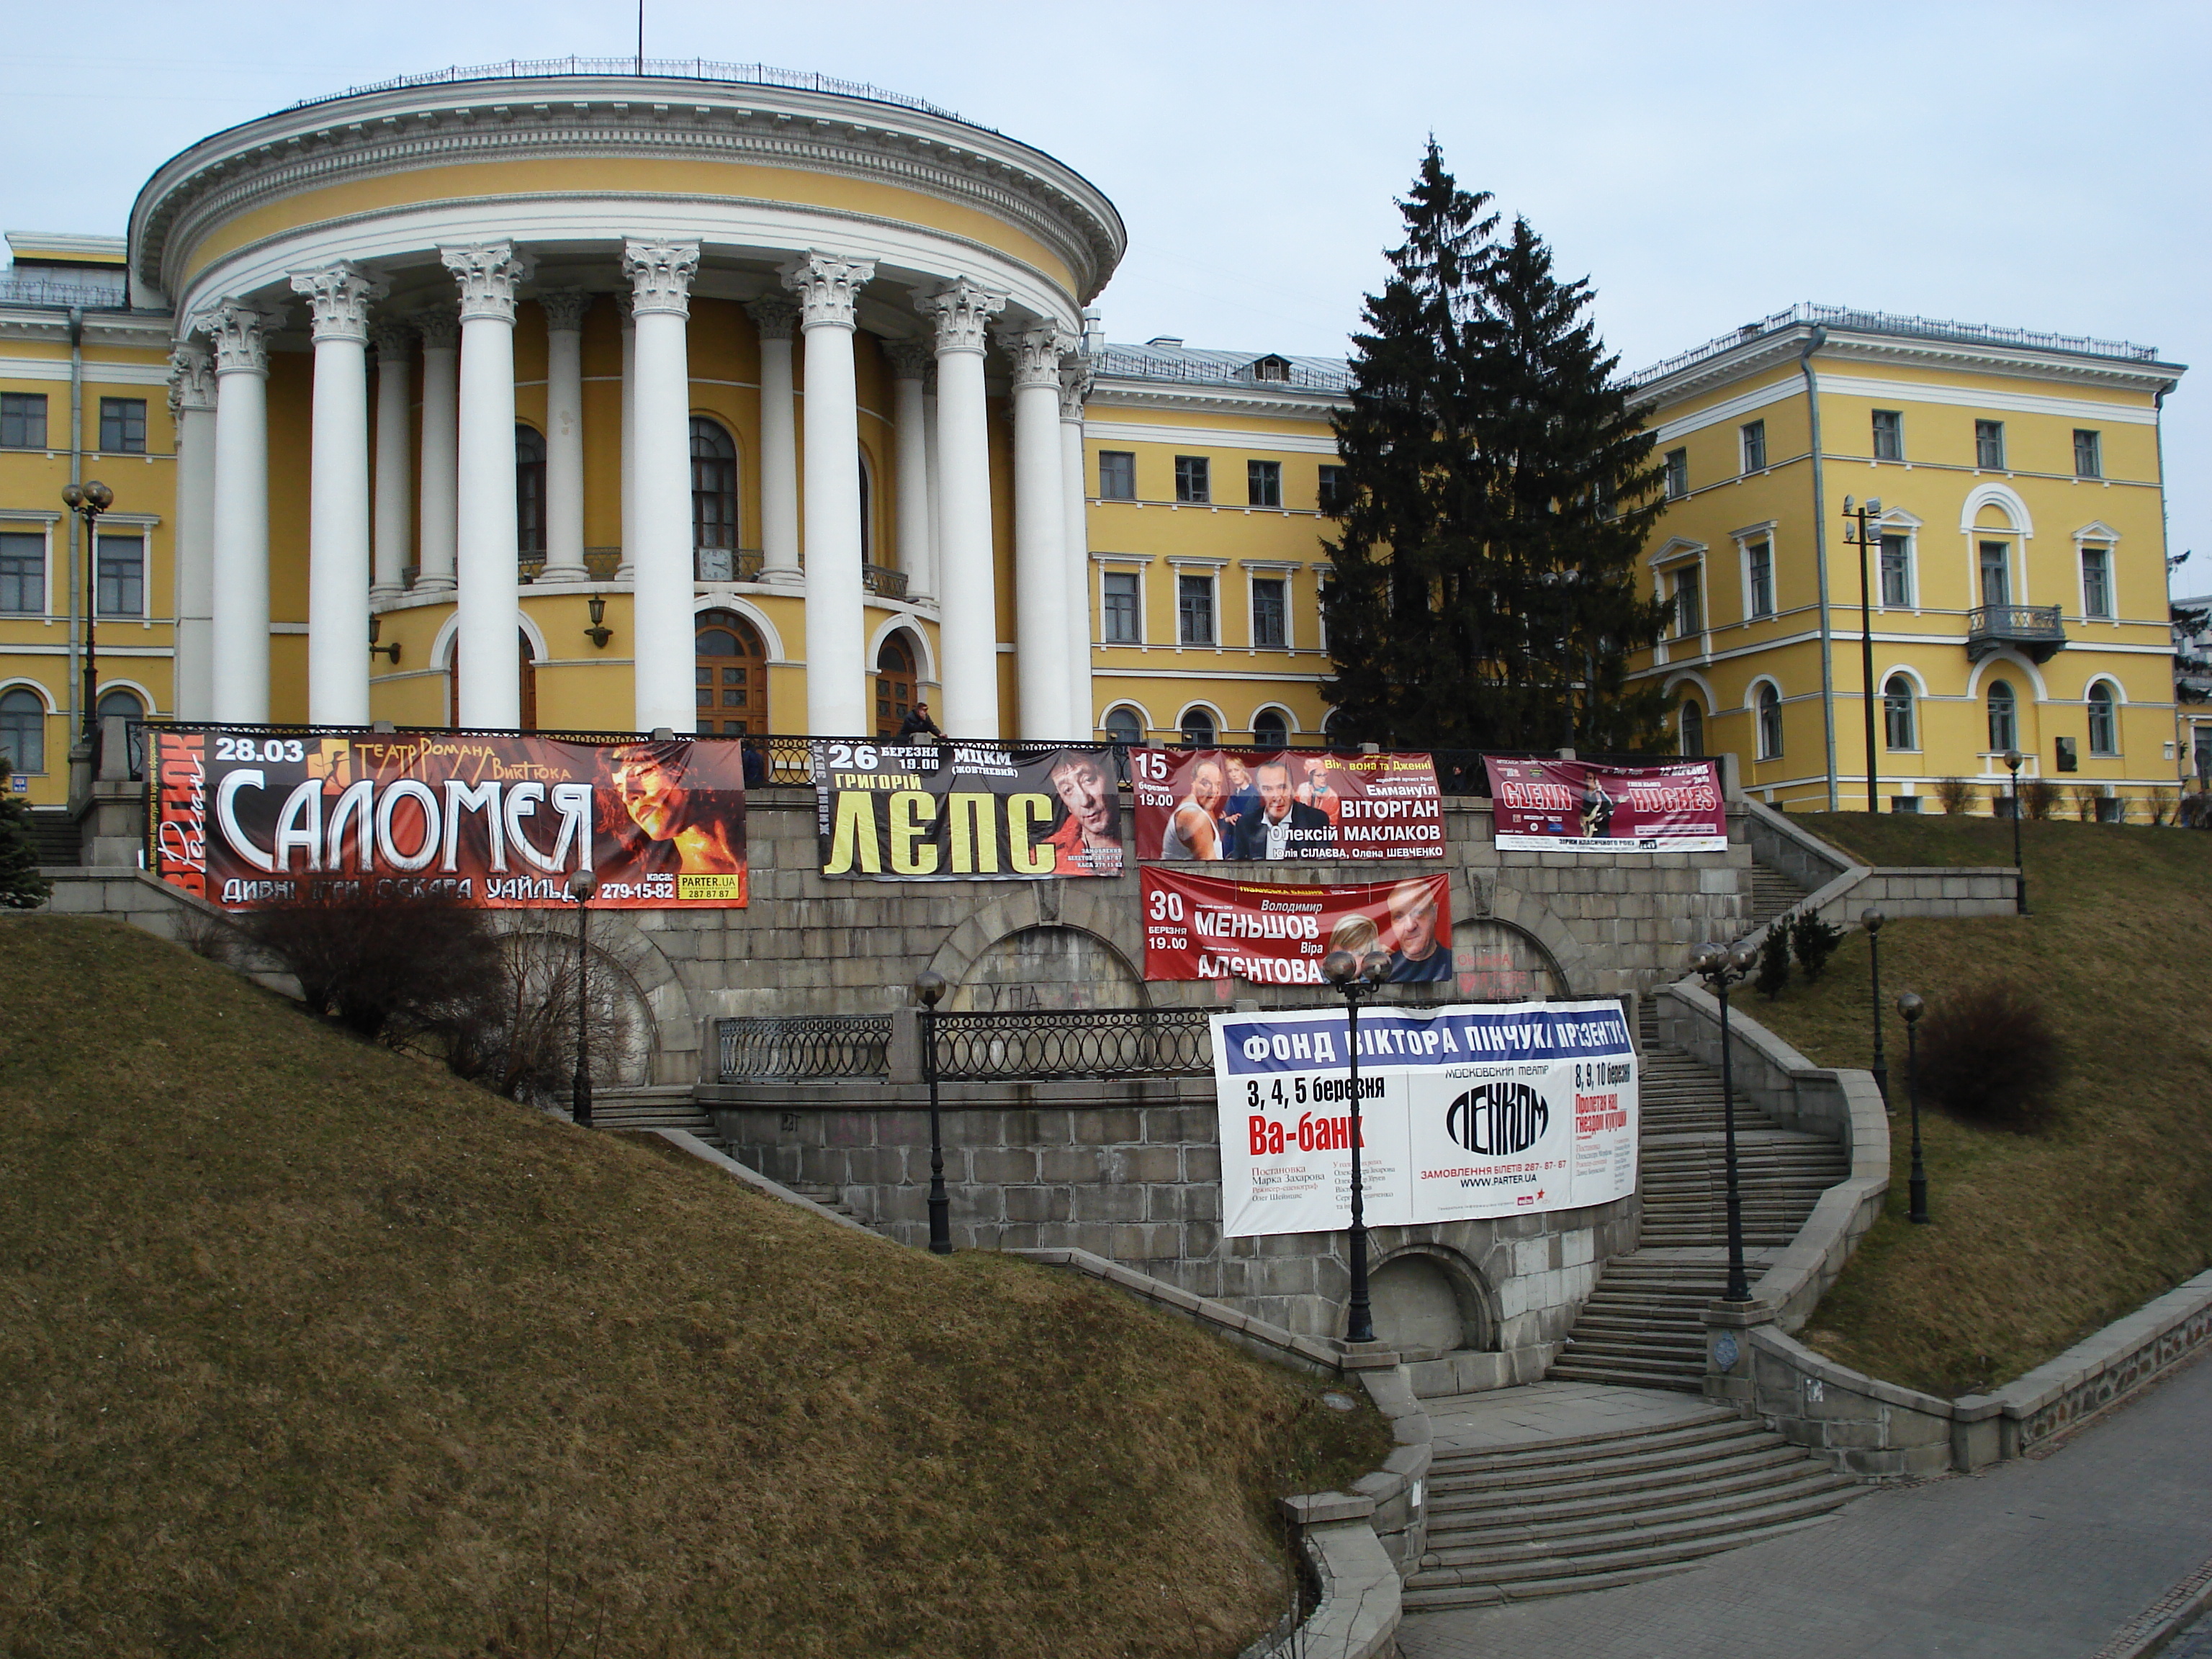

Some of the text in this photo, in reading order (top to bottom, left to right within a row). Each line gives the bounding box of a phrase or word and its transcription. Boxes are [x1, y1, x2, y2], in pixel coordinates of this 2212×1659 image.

[215, 738, 305, 762] 28.03
[828, 744, 878, 770] 26
[881, 745, 939, 759] БЕРЕЗНЯ
[953, 747, 1012, 768] МЦКМ
[899, 758, 939, 770] 19.00
[951, 765, 1018, 778] (ЖОВТНЕВИЙ)
[1135, 753, 1167, 780] 15
[1324, 759, 1346, 771] Він,
[1393, 760, 1431, 771] Дженні
[813, 745, 830, 835] ЖИВИЙ ЗВУК
[835, 773, 922, 791] ГРИГОРІЙ
[1366, 783, 1437, 799] Еммануїл
[1139, 793, 1174, 806] 19.00
[1501, 781, 1717, 812] GLENN HUGHES
[1341, 799, 1439, 819] ВІТОРГАН
[1270, 824, 1441, 842] Олексій МАКЛАКОВ
[1273, 846, 1443, 860] Юлія СІЛАЄВА, Олена ШЕВЧЕНКО
[646, 873, 673, 881] каса:
[682, 877, 735, 886] PARTER.UA
[220, 878, 295, 904] ДИВНІ
[601, 883, 674, 899] 279-15-82
[1149, 890, 1184, 922] 30
[1261, 899, 1323, 914] Володимир
[1148, 925, 1187, 935] БЕРЕЗНЯ
[1194, 911, 1319, 940] МЕНЬШОВ
[1148, 937, 1187, 950] 19.00
[1300, 941, 1323, 955] Віра
[1243, 1031, 1336, 1064] ФОНД
[1344, 1028, 1460, 1056] ВІКТОРА
[1575, 1064, 1584, 1092] 8,
[1586, 1062, 1594, 1091] 9,
[1597, 1062, 1606, 1086] 10
[1247, 1076, 1385, 1111] 3, 4, 5 березня
[1575, 1093, 1618, 1115] Пролетая над
[1446, 1082, 1549, 1156] ЛЕНКОМ
[1575, 1110, 1627, 1135] гнездом кукушки
[1249, 1111, 1365, 1156] Ва-банк
[1251, 1166, 1306, 1177] Постановка
[1252, 1173, 1325, 1185] Марка Захарова
[1421, 1166, 1492, 1179] ЗАМОВЛЕННЯ
[1494, 1164, 1522, 1174] БІЛЕТІВ
[1460, 1174, 1537, 1188] WWW.PARTER.UA
